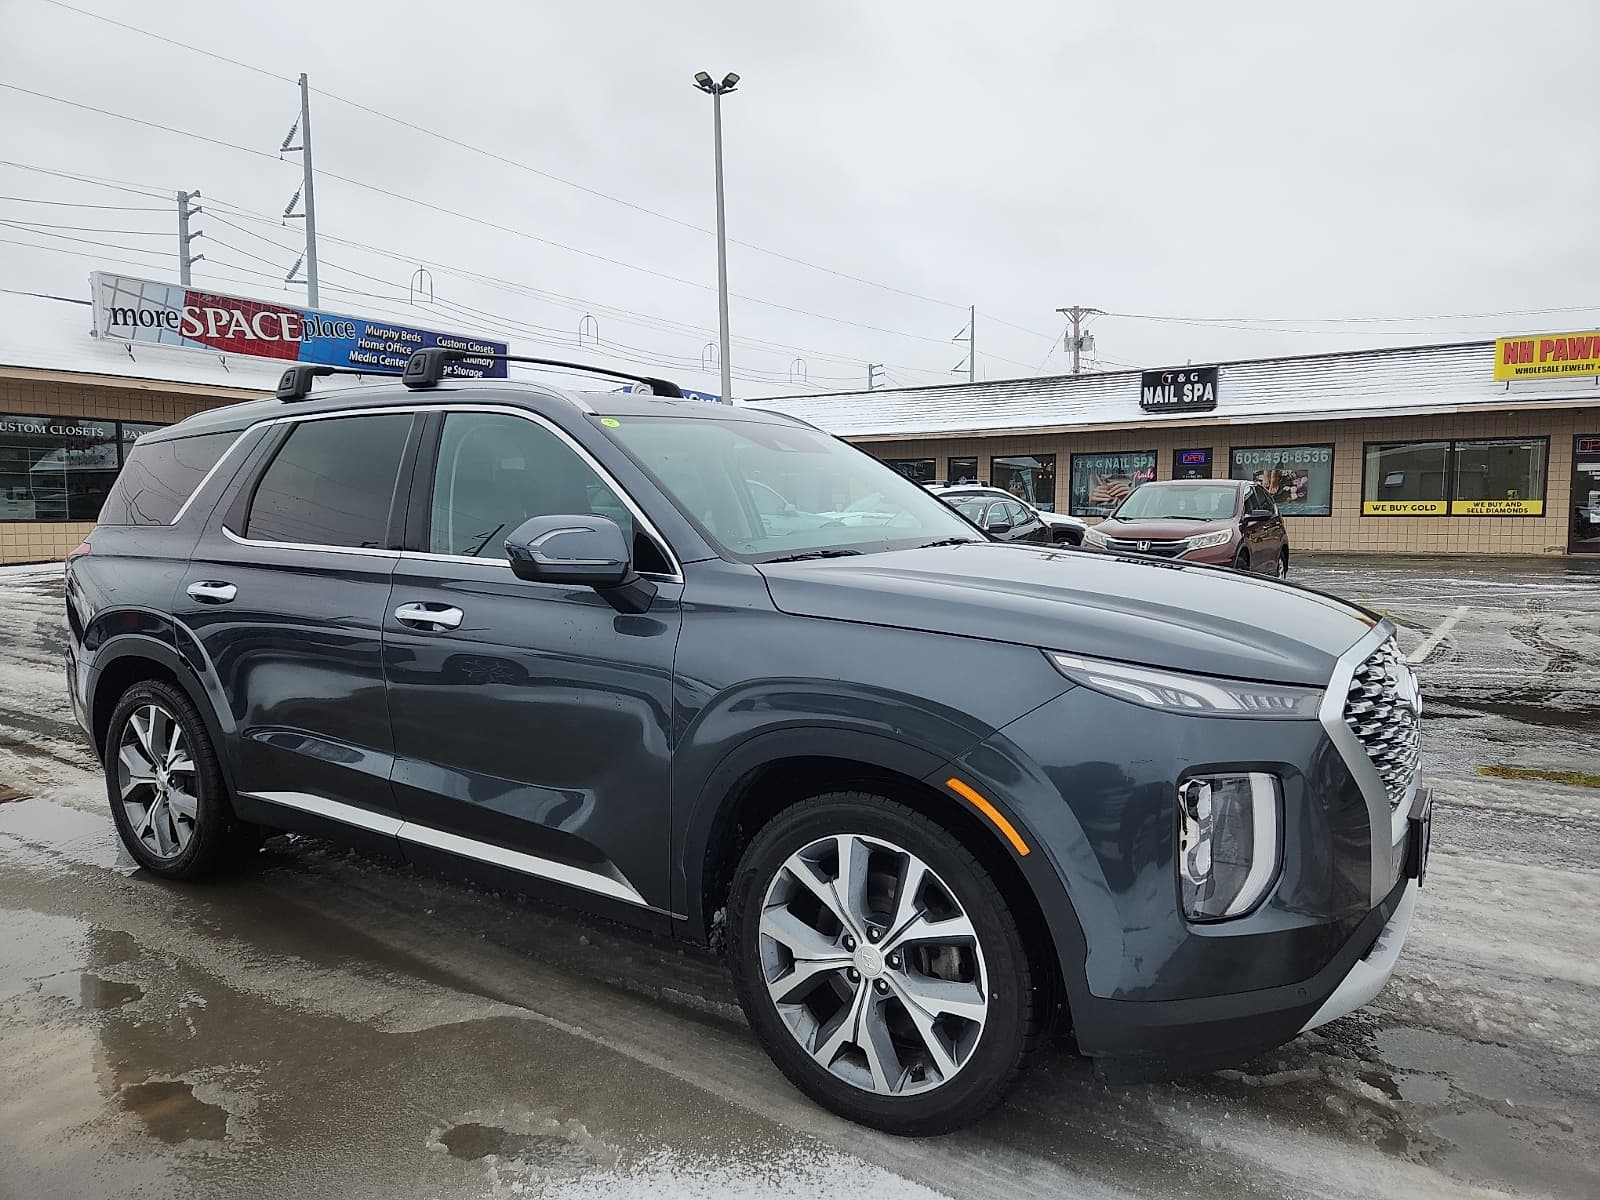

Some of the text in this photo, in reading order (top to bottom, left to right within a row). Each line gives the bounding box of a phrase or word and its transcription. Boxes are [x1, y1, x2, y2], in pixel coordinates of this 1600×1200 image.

[365, 325, 422, 343] Murphy Beds
[358, 338, 412, 355] Home Office
[436, 336, 495, 355] Custom Closets
[1503, 340, 1535, 365] NH
[349, 350, 379, 364] Media
[453, 364, 483, 379] Storage
[1515, 363, 1595, 375] WHOLESALE JEWELRY
[1165, 372, 1199, 383] T & G
[1143, 382, 1214, 405] NAIL SPA
[50, 425, 104, 437] CLOSETS
[1105, 458, 1130, 469] NAIL
[1133, 456, 1155, 468] SPA
[1183, 454, 1204, 462] OPEN
[1235, 450, 1329, 465] 603-458-8536
[1372, 504, 1437, 512] WE BUY GOLD
